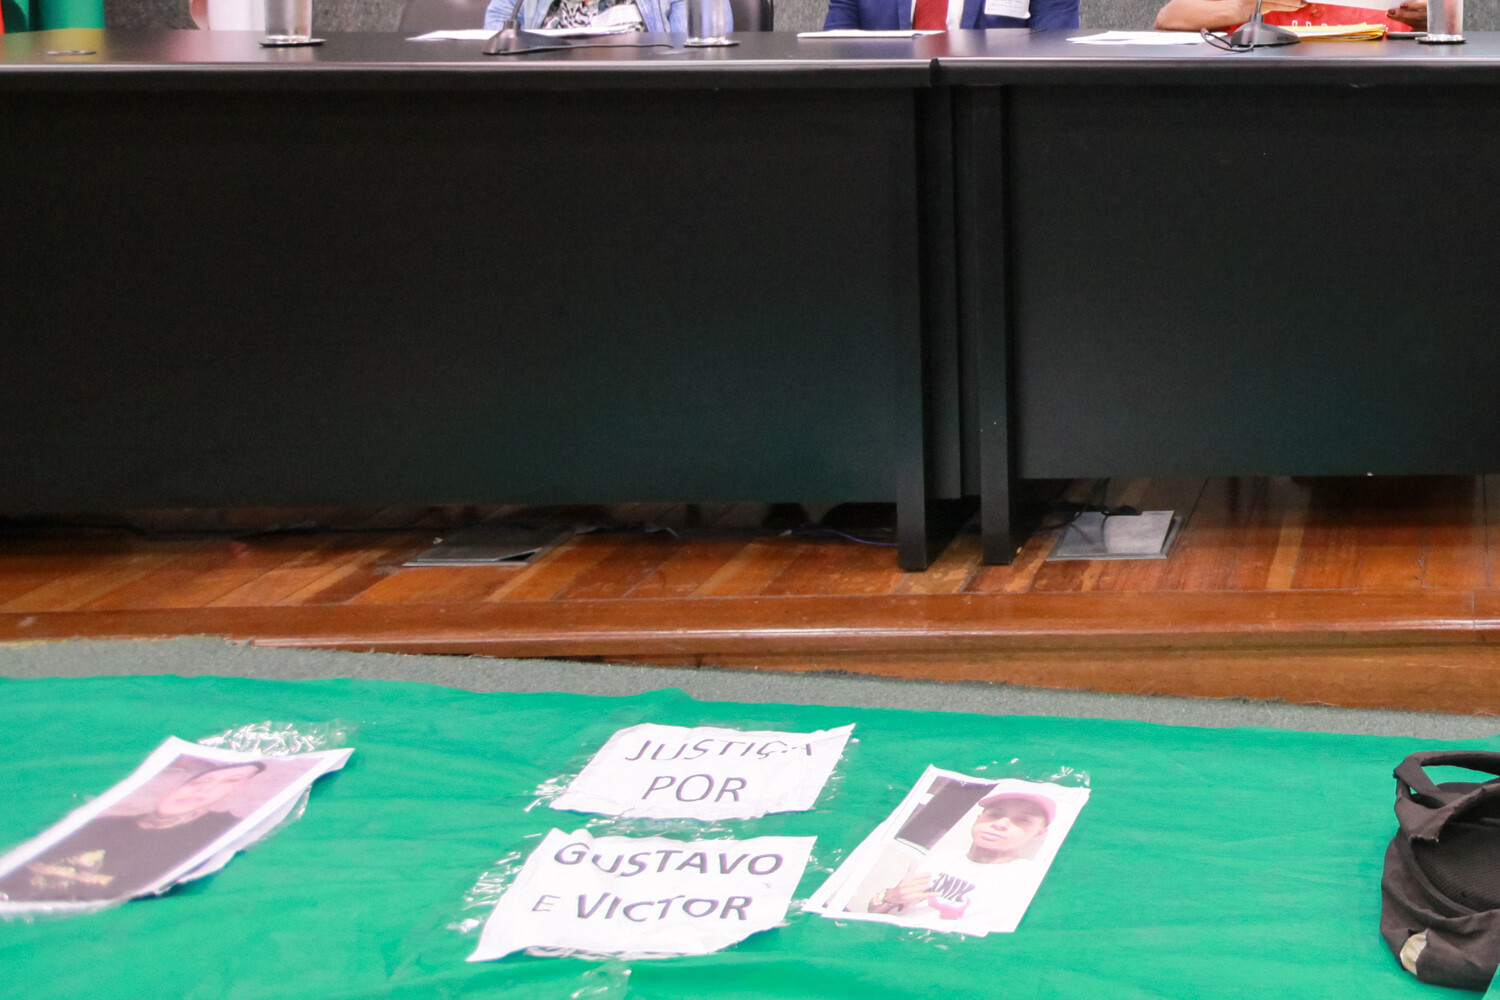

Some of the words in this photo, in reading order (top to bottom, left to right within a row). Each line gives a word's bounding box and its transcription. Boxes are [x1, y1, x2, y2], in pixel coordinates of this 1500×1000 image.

[625, 739, 814, 762] JUSTIÇA
[641, 773, 747, 803] POR
[552, 841, 784, 878] GUSTAVO
[531, 894, 561, 912] E
[577, 892, 753, 922] VICTOR
